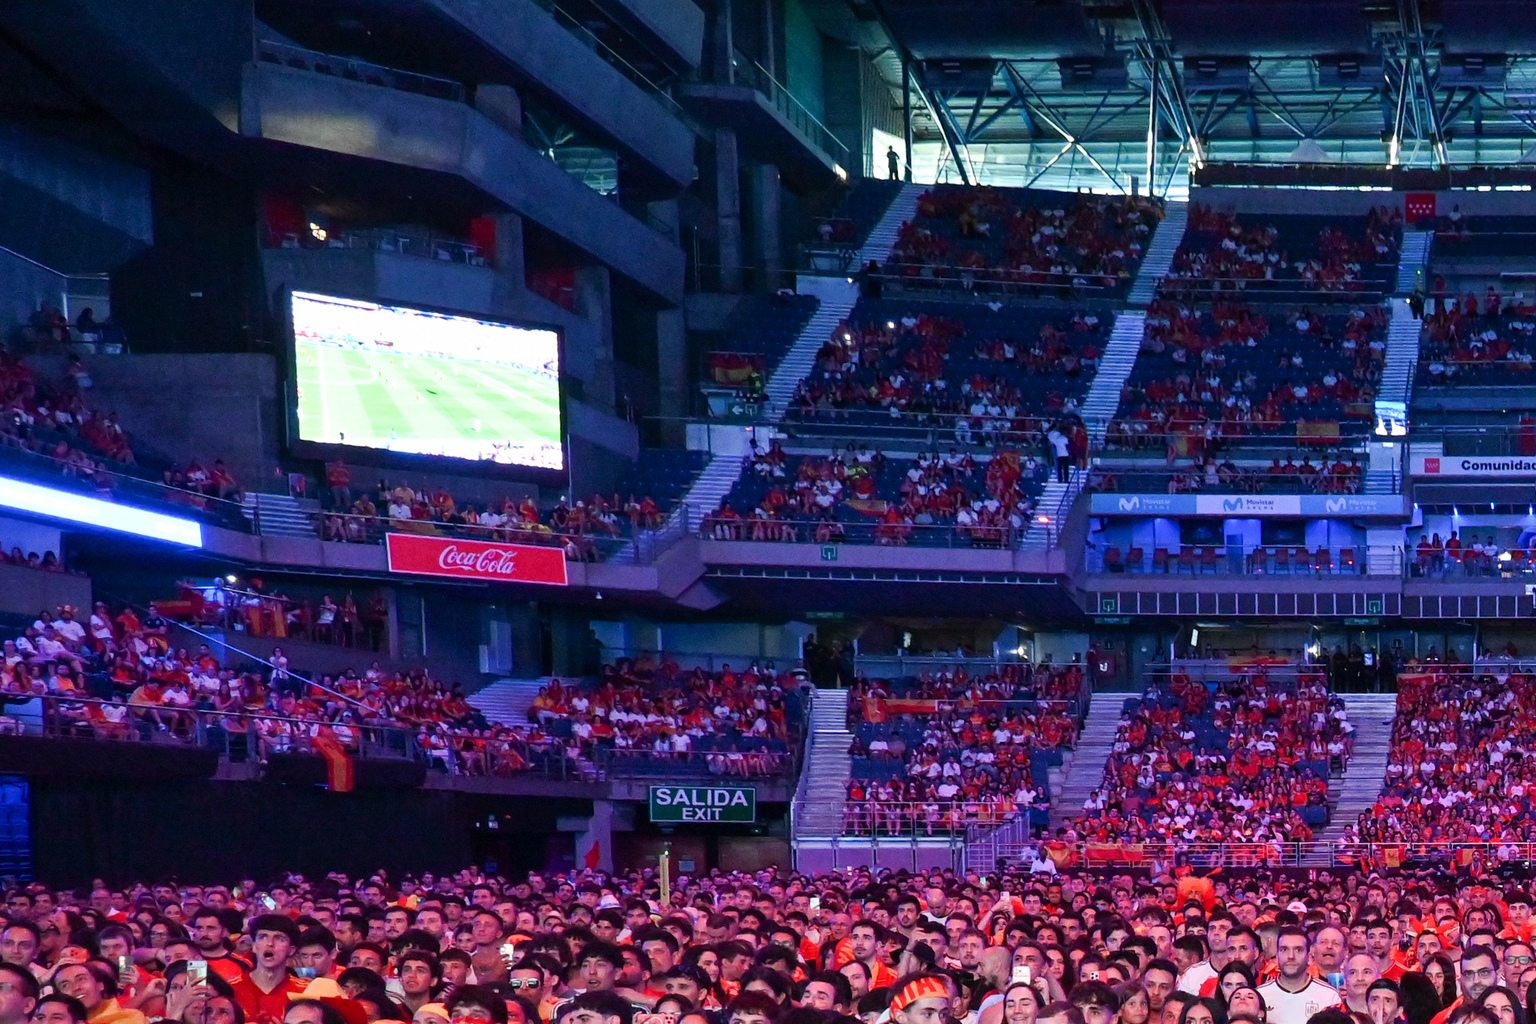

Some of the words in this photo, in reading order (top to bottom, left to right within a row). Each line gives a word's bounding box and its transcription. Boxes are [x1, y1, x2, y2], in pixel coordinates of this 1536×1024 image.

[439, 545, 518, 574] Coca-Cola
[656, 788, 749, 806] SALIDA
[682, 807, 723, 821] EXIT
